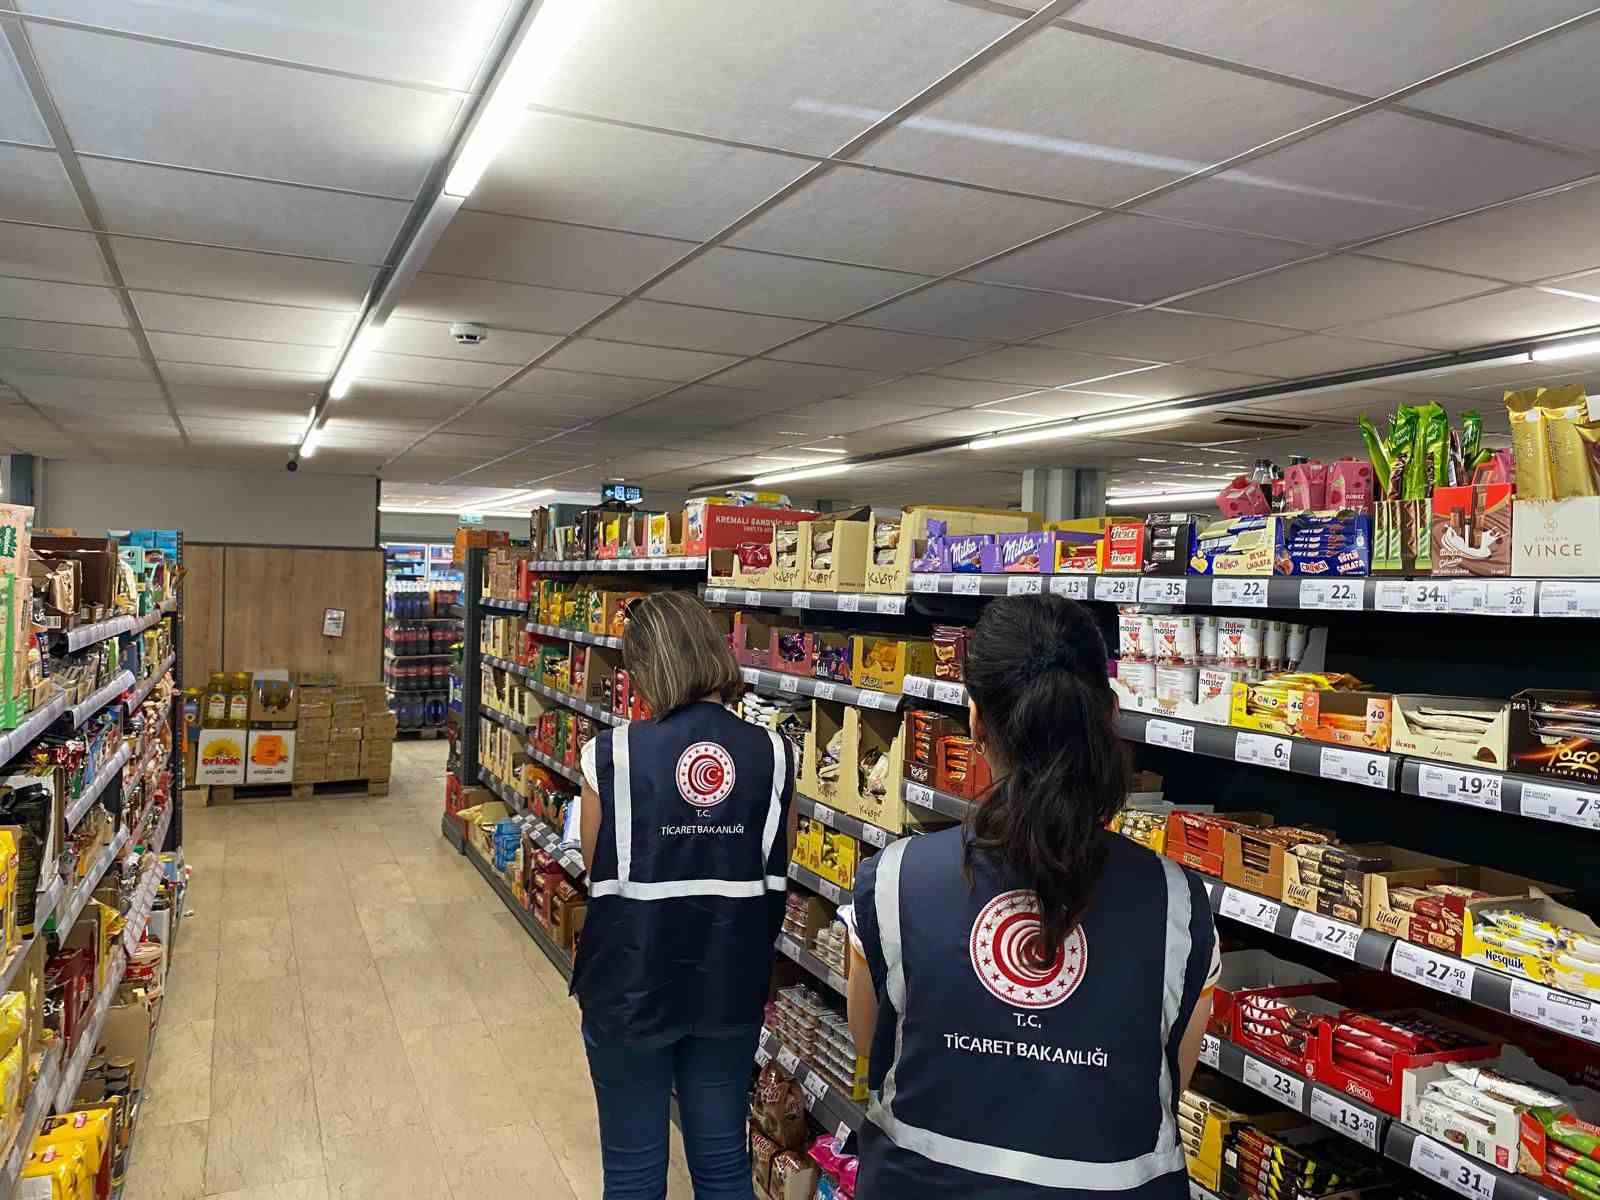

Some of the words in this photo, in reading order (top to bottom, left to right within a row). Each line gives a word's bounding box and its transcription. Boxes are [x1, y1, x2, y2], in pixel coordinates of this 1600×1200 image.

[950, 537, 977, 563] Milka
[1002, 535, 1034, 563] Milka
[1523, 544, 1583, 557] VINCE
[1166, 583, 1180, 595] 35
[1243, 582, 1259, 596] 22
[1331, 584, 1350, 600] 22
[1417, 585, 1440, 602] 34
[1219, 627, 1244, 635] master
[1200, 679, 1224, 688] master
[1274, 743, 1283, 759] 6
[1367, 760, 1377, 775] 6
[696, 809, 711, 818] T.C.
[662, 824, 697, 836] TİCARET
[697, 823, 745, 835] BAKANLIĞI
[1485, 949, 1525, 970] Nesquik
[1012, 1012, 1042, 1028] T.C.
[943, 1032, 1014, 1056] TİCARET
[1016, 1042, 1109, 1067] BAKANLIĞI
[1273, 1074, 1291, 1094] 23
[1457, 1166, 1482, 1192] 31
